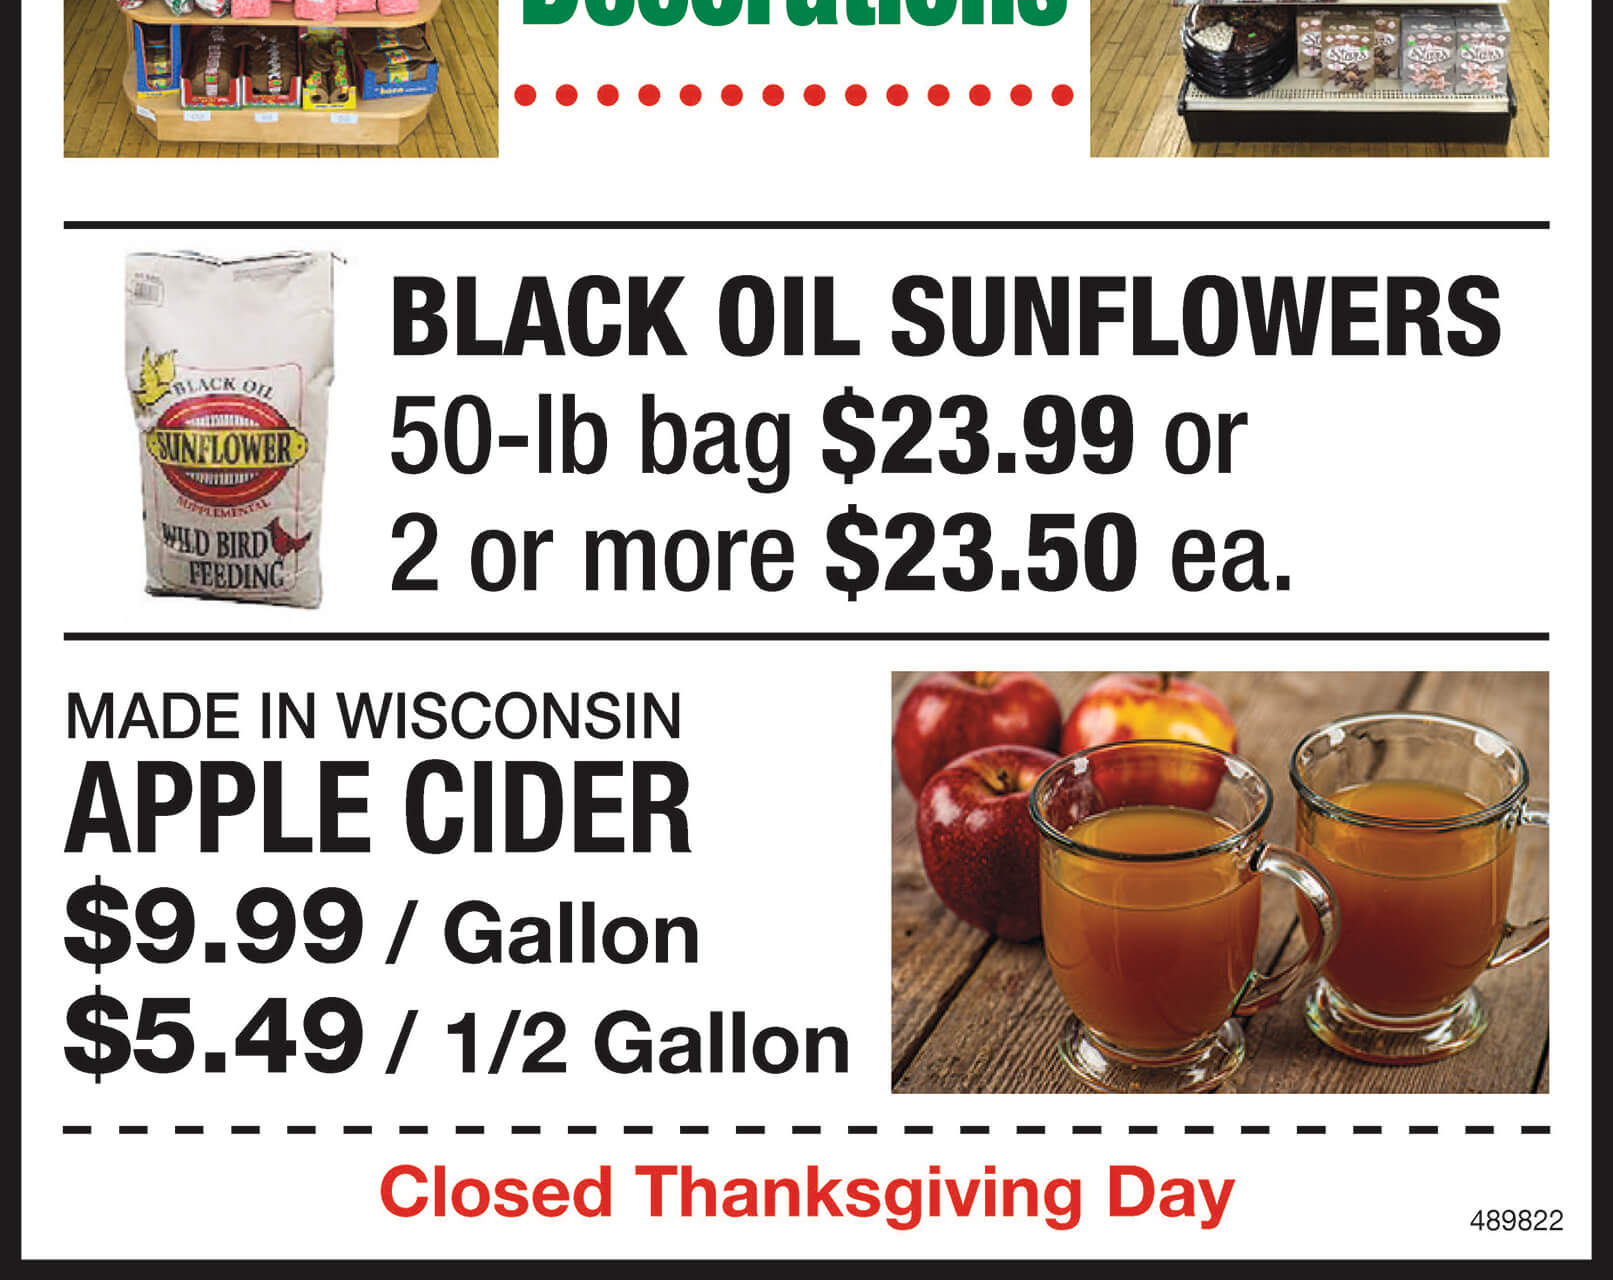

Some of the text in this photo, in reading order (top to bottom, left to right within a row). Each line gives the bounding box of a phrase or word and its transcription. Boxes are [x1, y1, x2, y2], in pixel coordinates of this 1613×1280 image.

[394, 275, 1500, 357] BLACK OIL SUNFLOWERS
[173, 377, 273, 400] BLACK OIL
[157, 431, 291, 465] SUNFLOWER
[391, 386, 1248, 494] 50-lb bag $23.99 or
[176, 496, 272, 518] SUPPLEMENTAL
[162, 523, 268, 559] WILD BIRD
[392, 504, 1290, 602] 2 or more $23.50 ea.
[189, 560, 285, 590] FEEDING
[68, 692, 680, 739] MADE IN WISCONSIN
[64, 759, 692, 854] APPLE CIDER
[64, 875, 698, 974] $9.99 / Gallon
[64, 985, 849, 1084] $5.49 / 1/2 Gallon
[381, 1165, 1236, 1231] Closed Thanksgiving Day
[1471, 1210, 1563, 1231] 489822
